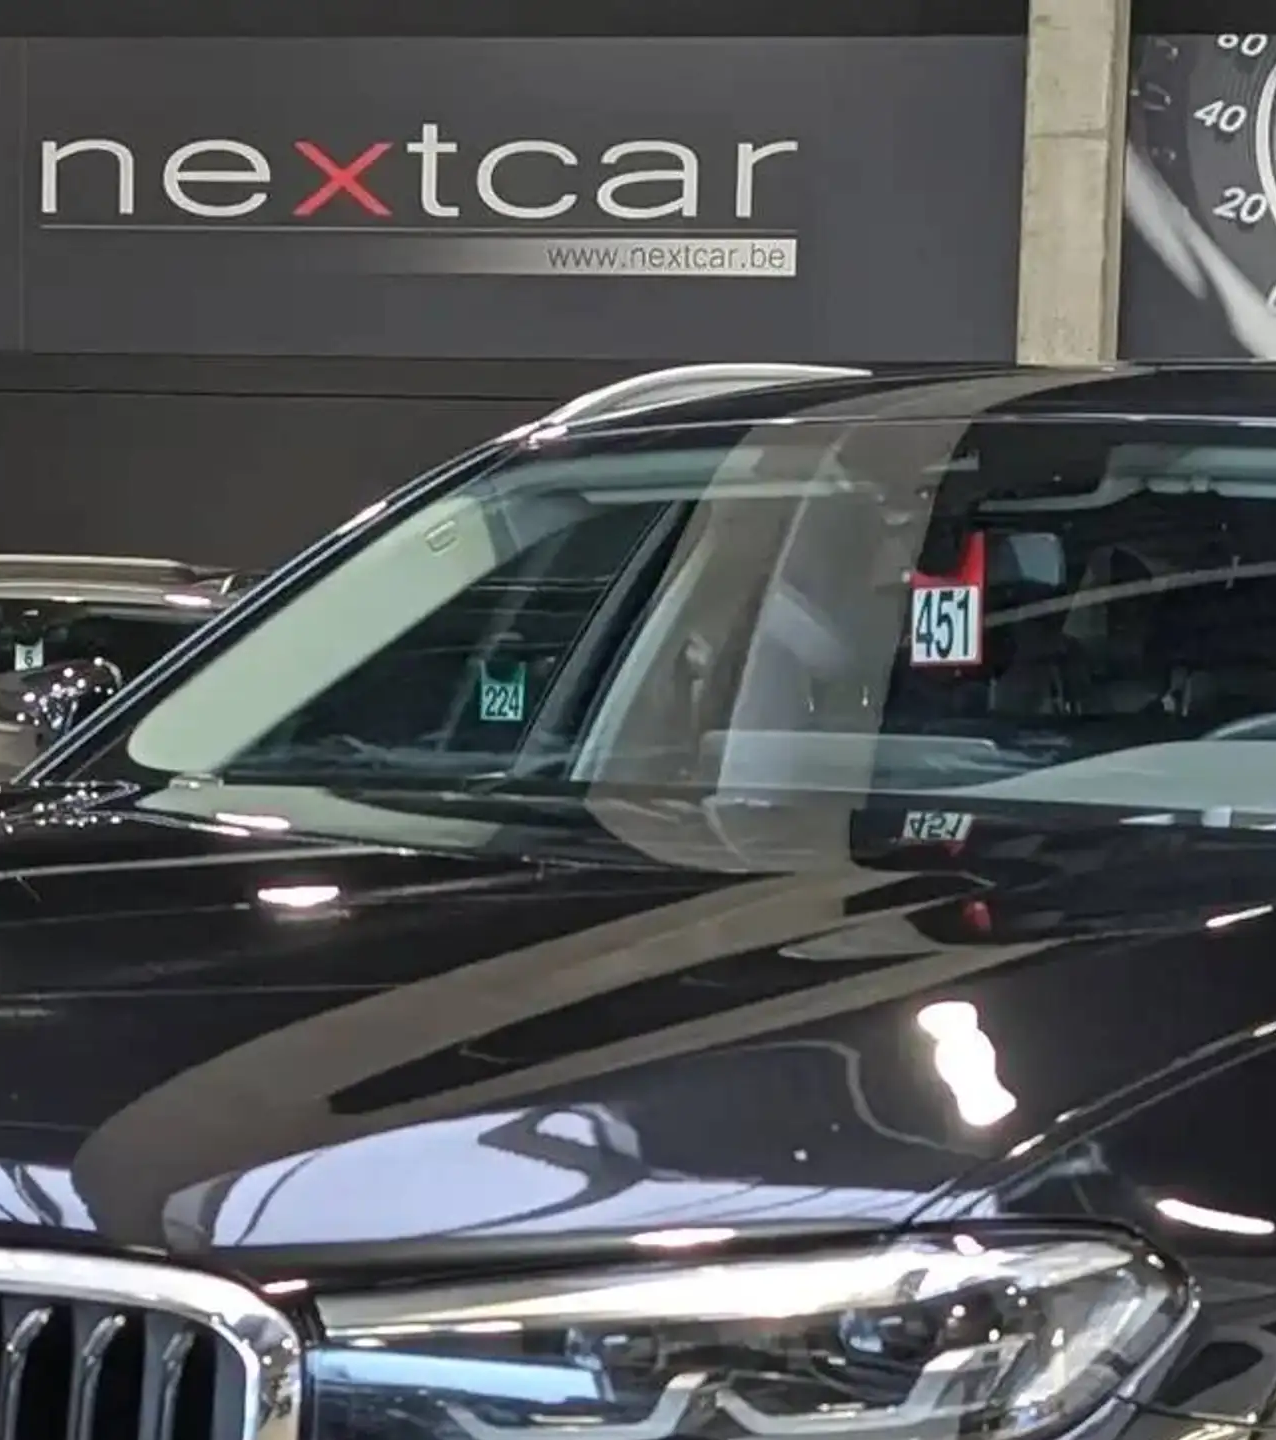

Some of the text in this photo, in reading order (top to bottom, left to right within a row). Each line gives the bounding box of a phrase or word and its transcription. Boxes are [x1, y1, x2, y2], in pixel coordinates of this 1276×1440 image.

[1192, 100, 1247, 133] 40
[40, 123, 799, 219] nextcar
[1212, 186, 1267, 224] 20
[547, 243, 787, 272] www.nextcar.be
[915, 589, 970, 659] 451
[484, 685, 521, 718] 224
